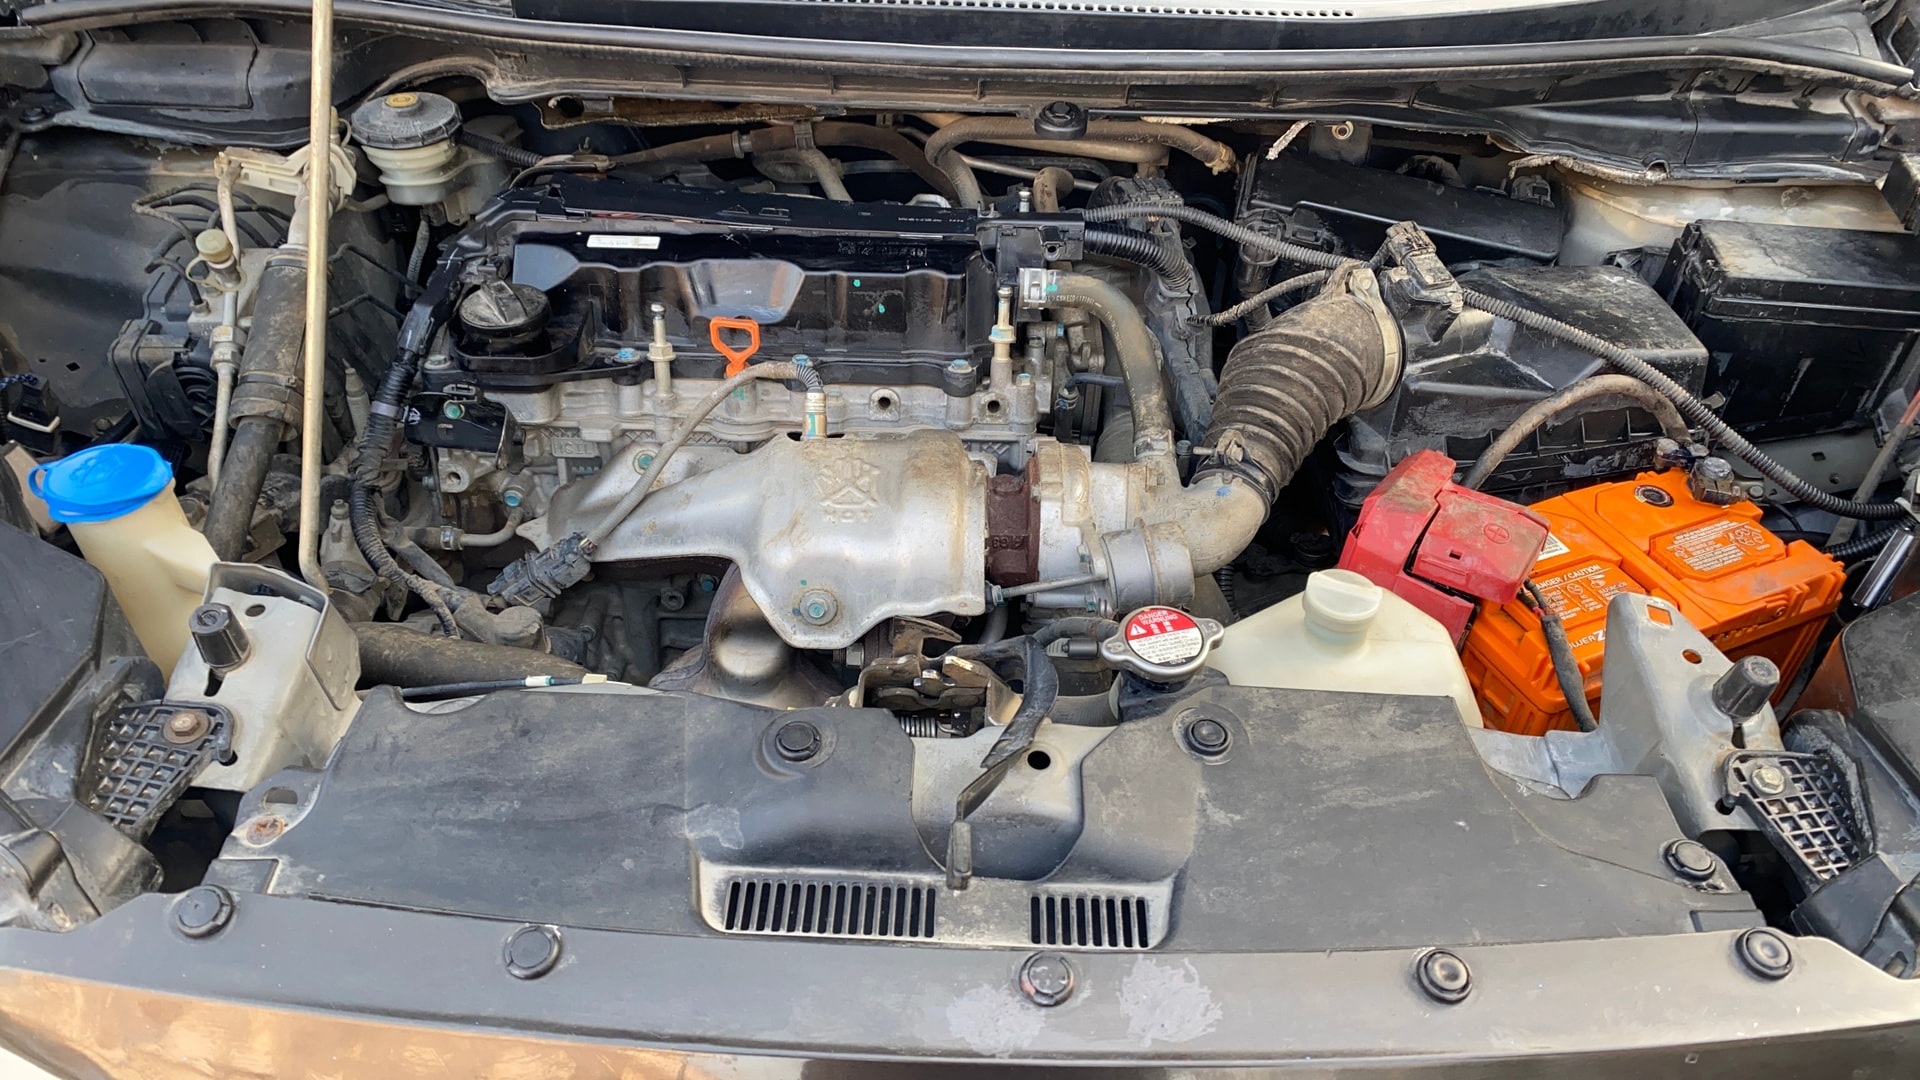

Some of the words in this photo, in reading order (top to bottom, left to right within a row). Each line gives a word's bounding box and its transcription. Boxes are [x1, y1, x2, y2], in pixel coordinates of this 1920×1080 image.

[1536, 577, 1563, 590] ANGER
[1567, 564, 1601, 579] CAUTION
[1138, 610, 1168, 621] DANGER
